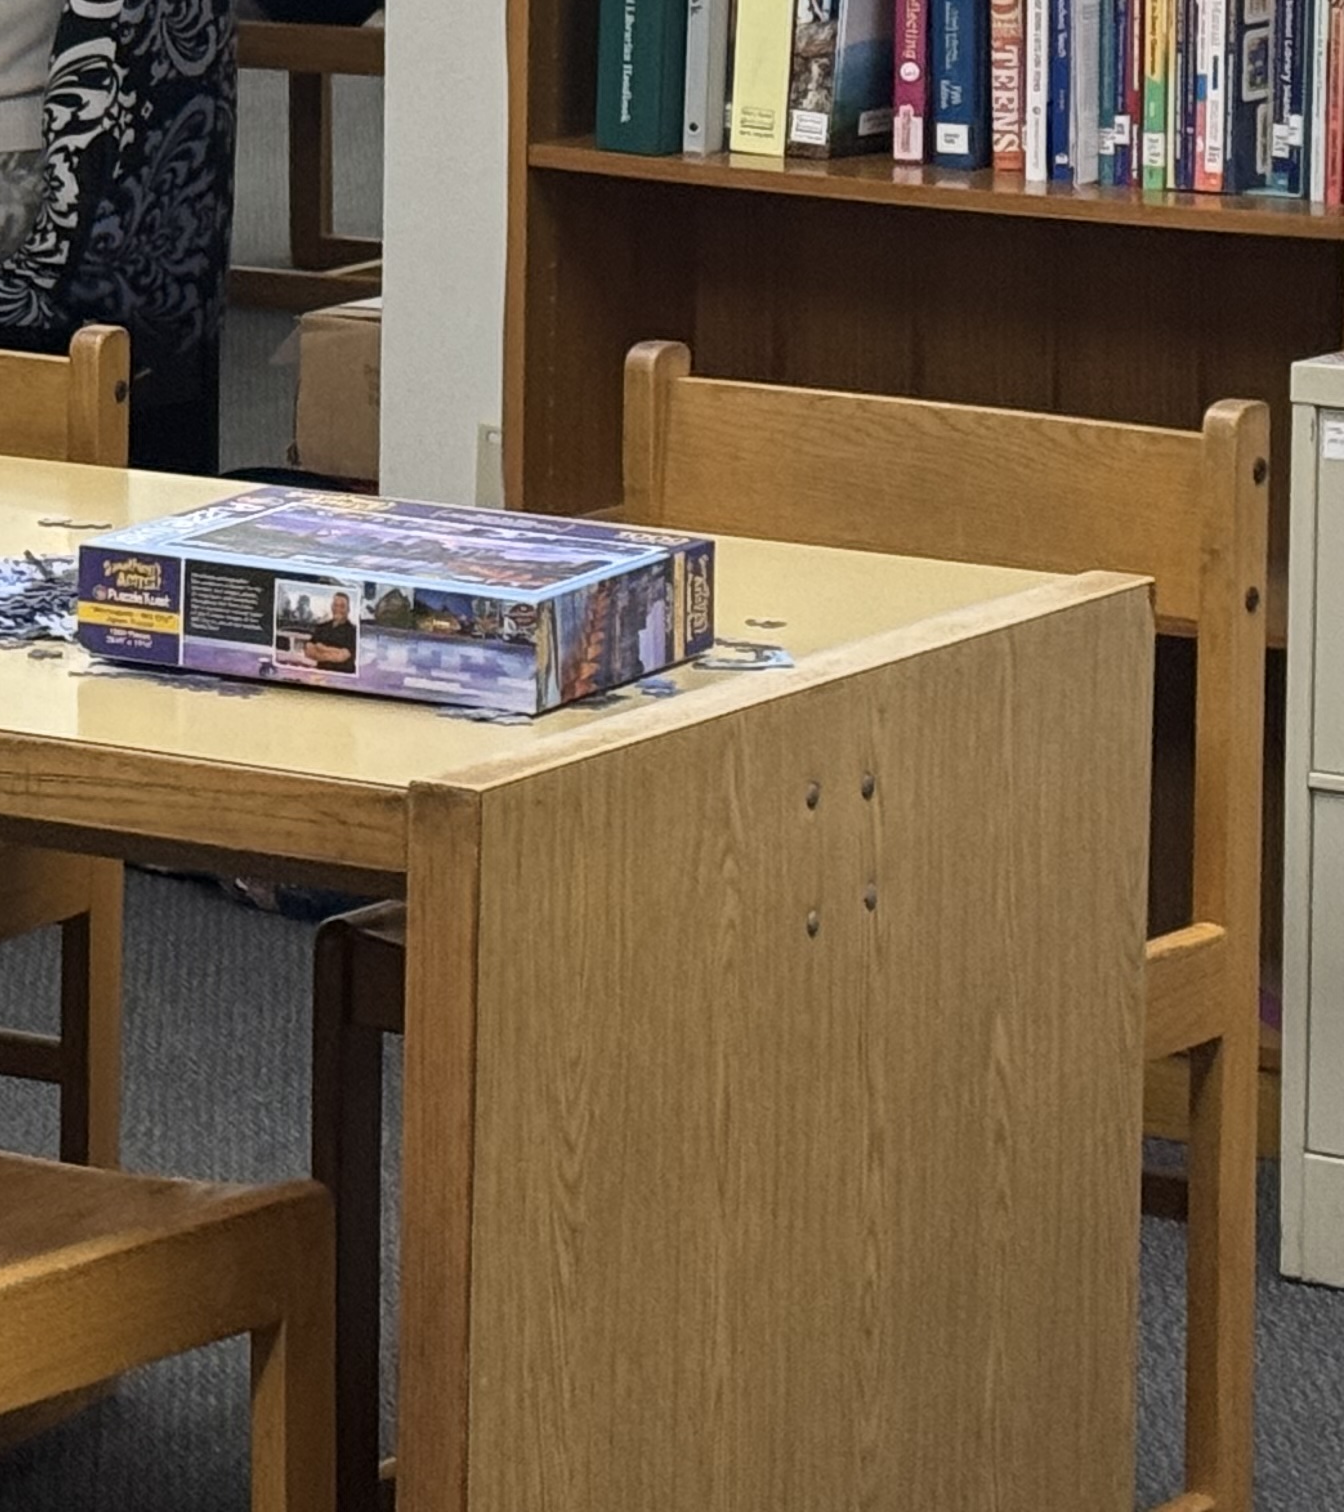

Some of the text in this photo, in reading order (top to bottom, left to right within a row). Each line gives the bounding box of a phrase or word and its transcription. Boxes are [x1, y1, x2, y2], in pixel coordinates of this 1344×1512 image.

[1283, 0, 1296, 39] School
[1281, 41, 1295, 83] Library
[618, 64, 633, 125] Handbook
[991, 45, 1020, 153] TEENS
